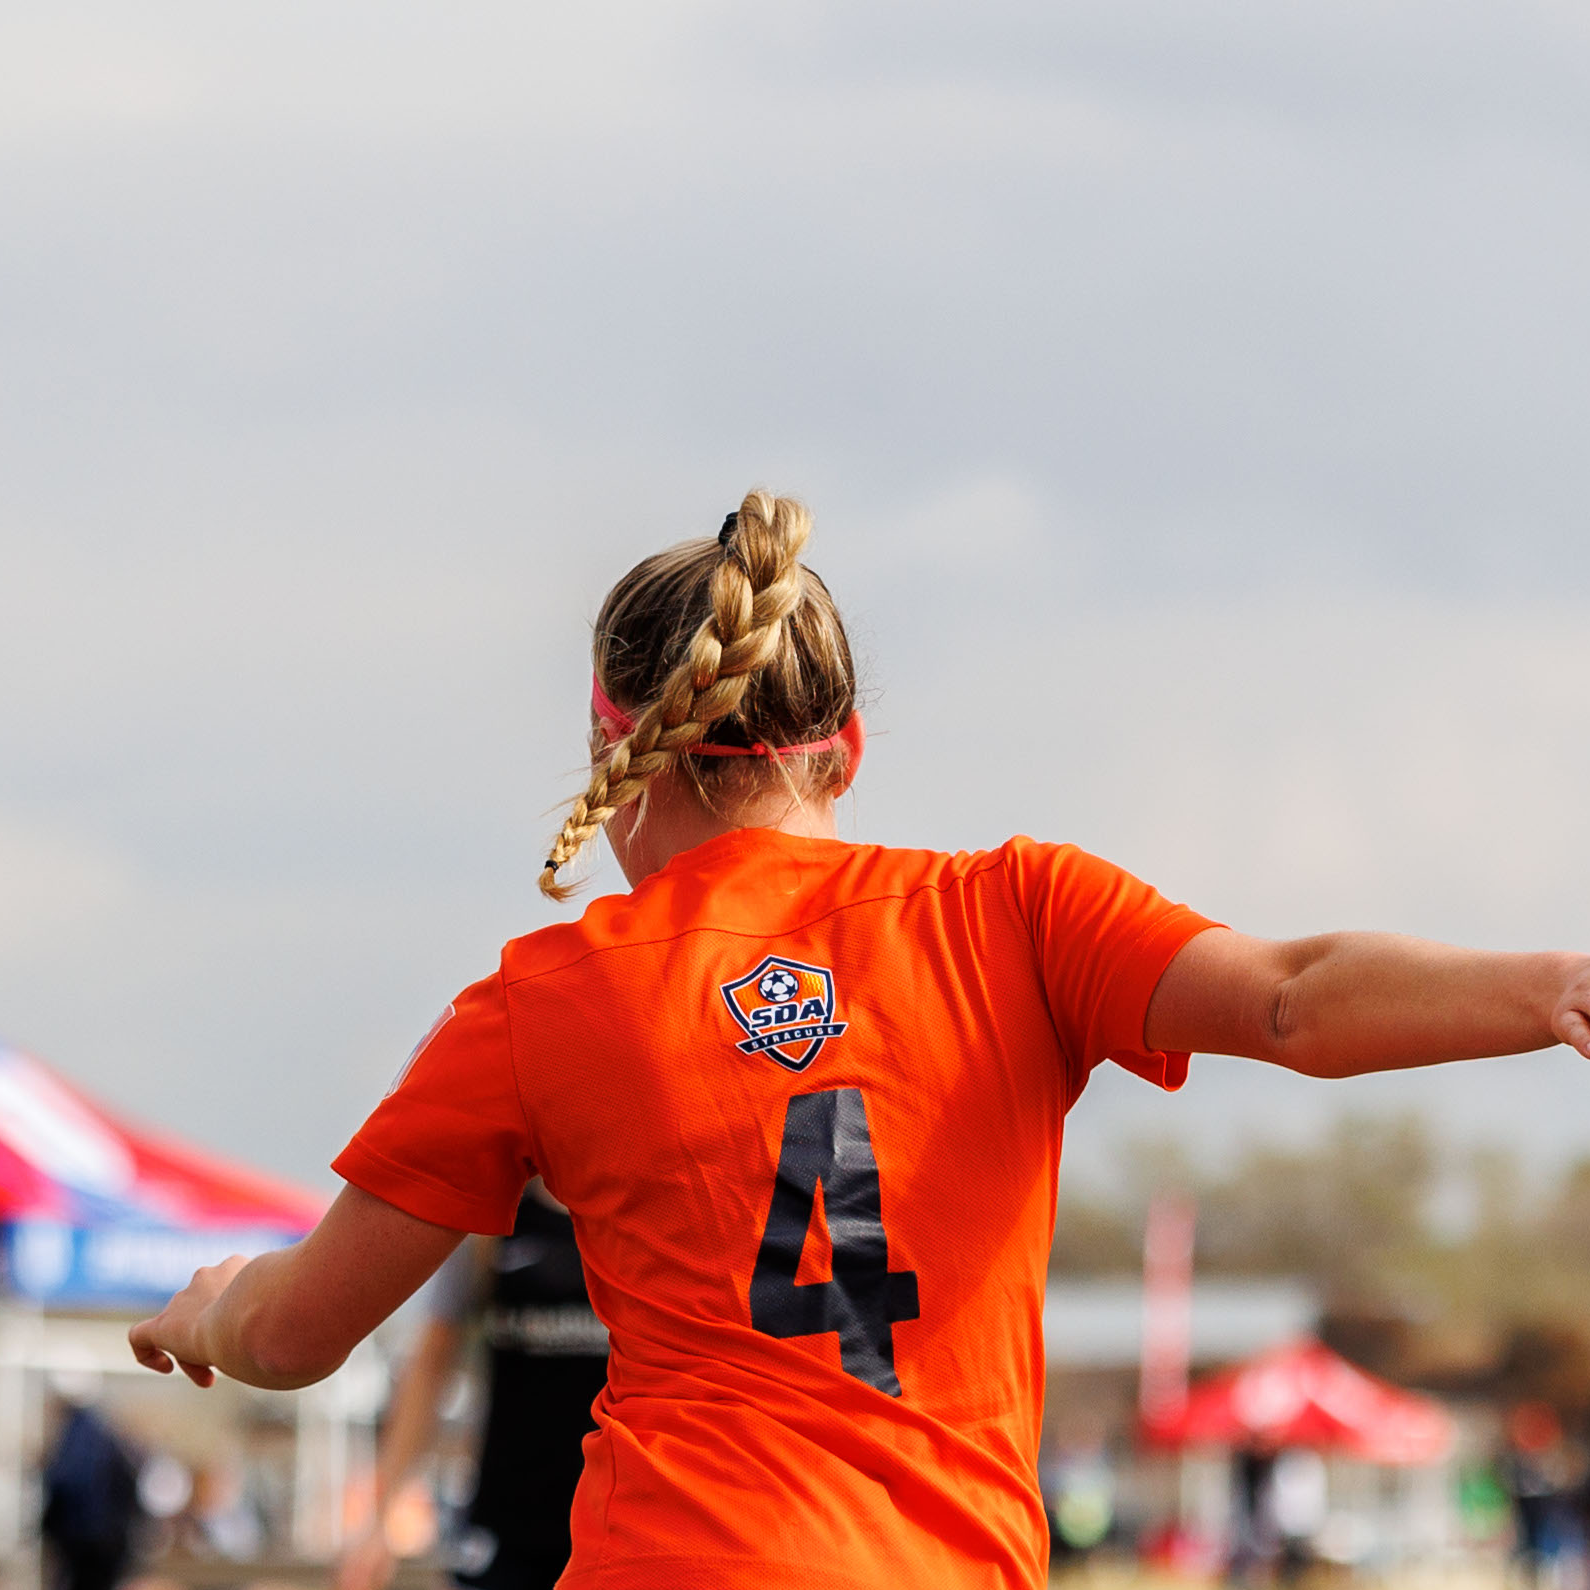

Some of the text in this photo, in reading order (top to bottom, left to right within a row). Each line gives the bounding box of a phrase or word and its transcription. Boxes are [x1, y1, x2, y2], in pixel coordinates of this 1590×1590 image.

[750, 998, 827, 1029] SDA
[751, 1026, 835, 1049] SYRACUSE
[749, 1088, 920, 1397] 4
